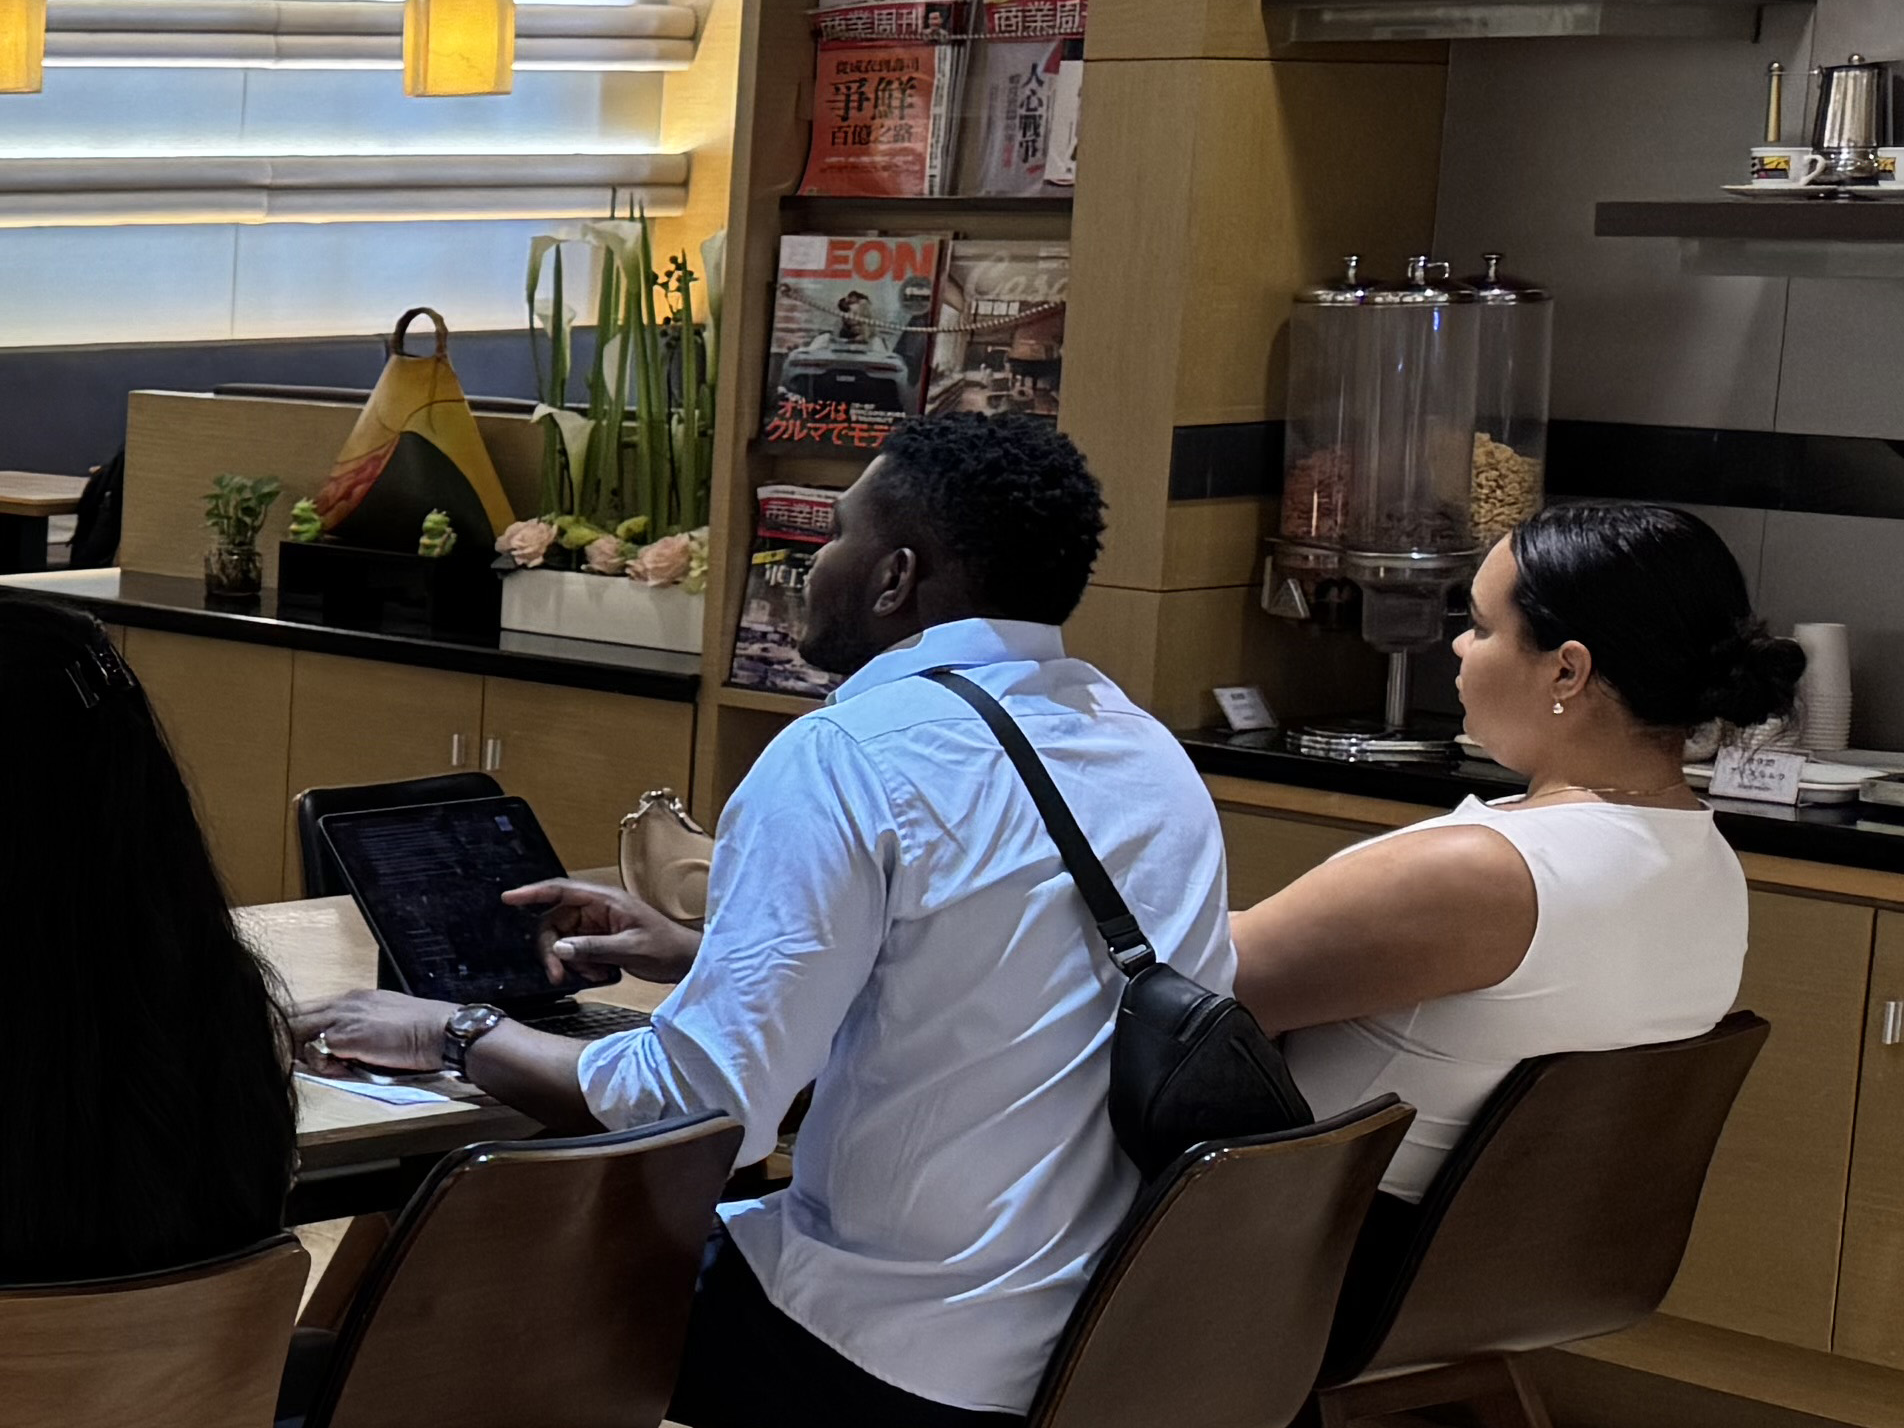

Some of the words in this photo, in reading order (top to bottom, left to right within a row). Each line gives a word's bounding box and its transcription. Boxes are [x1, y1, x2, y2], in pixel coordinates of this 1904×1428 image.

[993, 0, 1088, 35] 商業周
[777, 399, 847, 422] オヤジは
